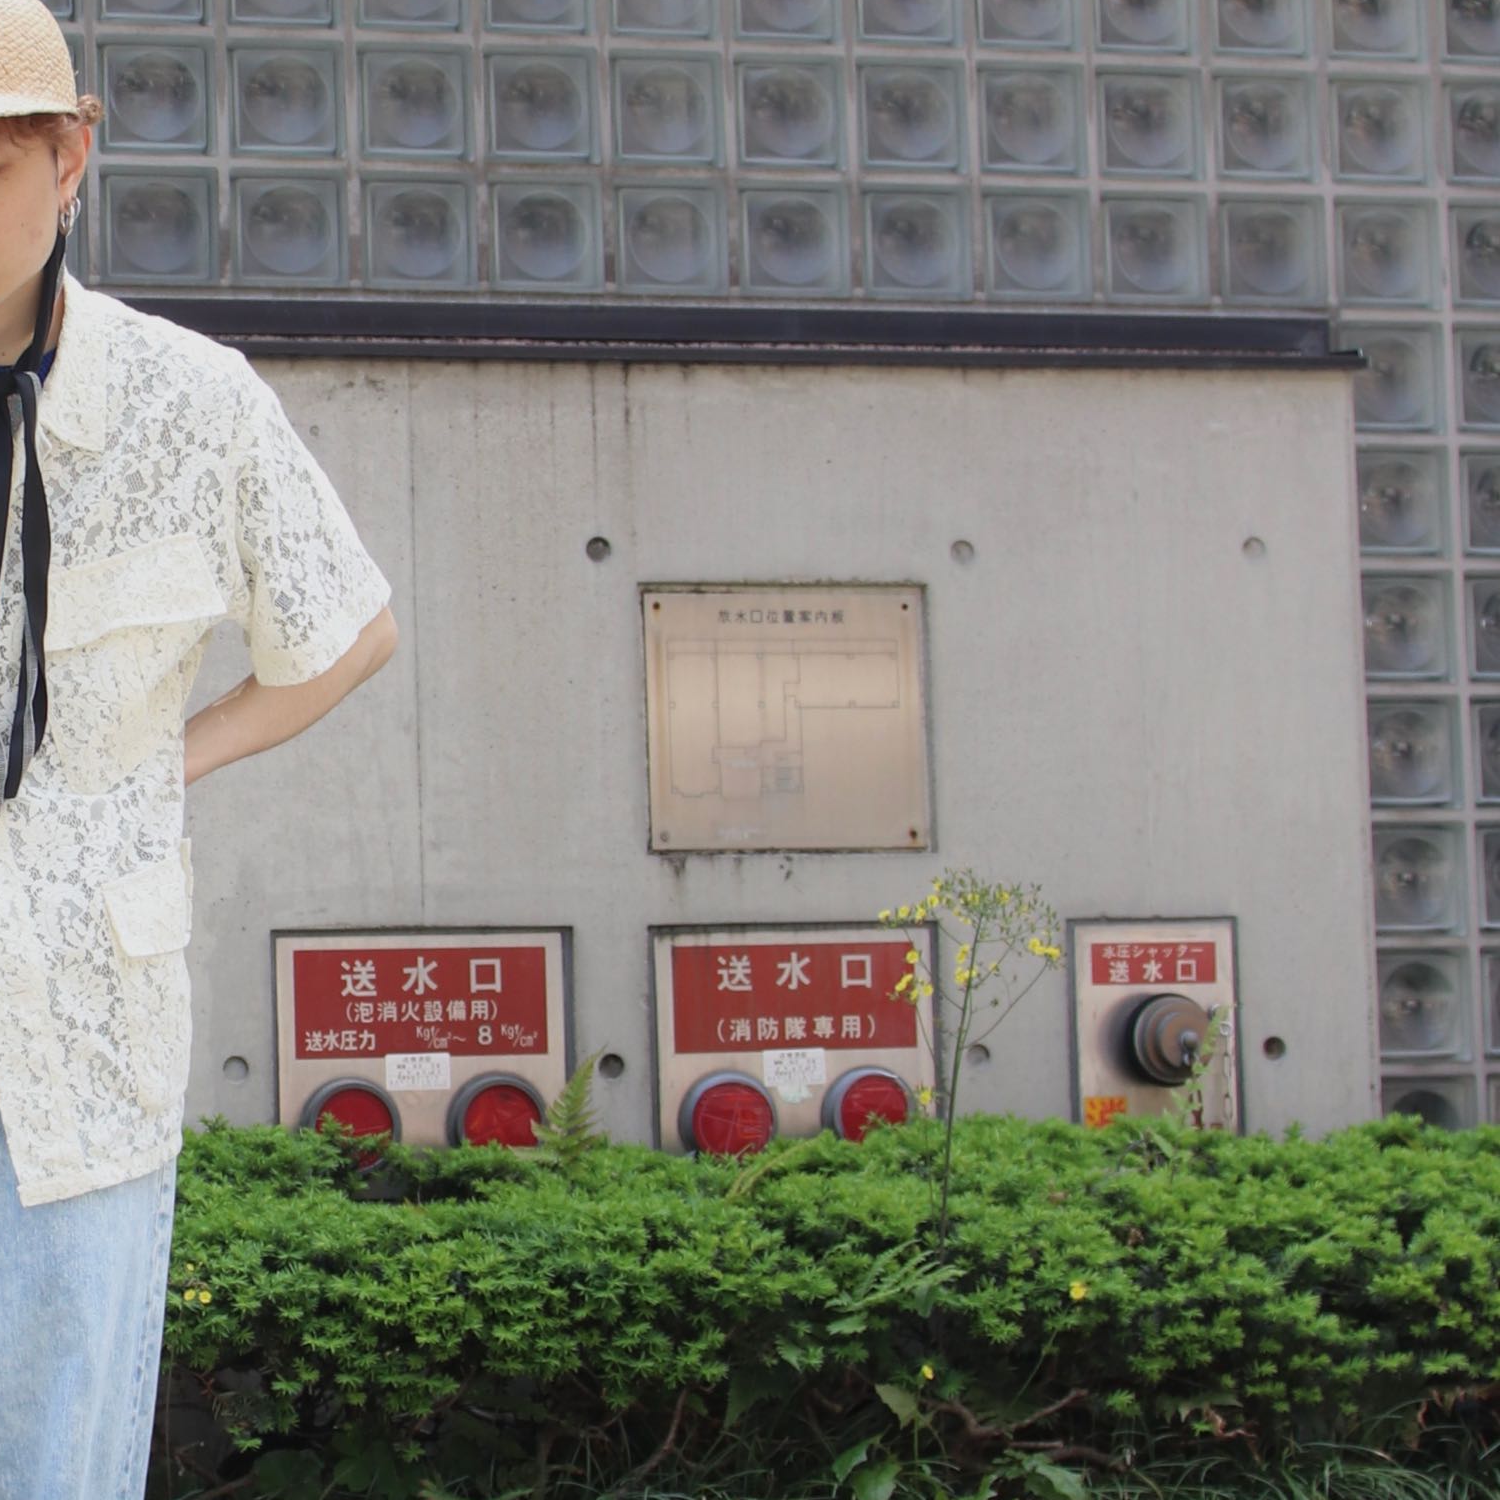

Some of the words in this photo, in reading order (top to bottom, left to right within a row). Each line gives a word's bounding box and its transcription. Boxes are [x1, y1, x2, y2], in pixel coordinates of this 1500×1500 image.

[1102, 944, 1204, 959] 水圧シャッター
[340, 956, 502, 997] 送水口
[716, 951, 872, 991] 送水口
[1109, 959, 1197, 983] 送水口
[304, 1029, 377, 1052] 送水圧力
[477, 1025, 493, 1046] 8
